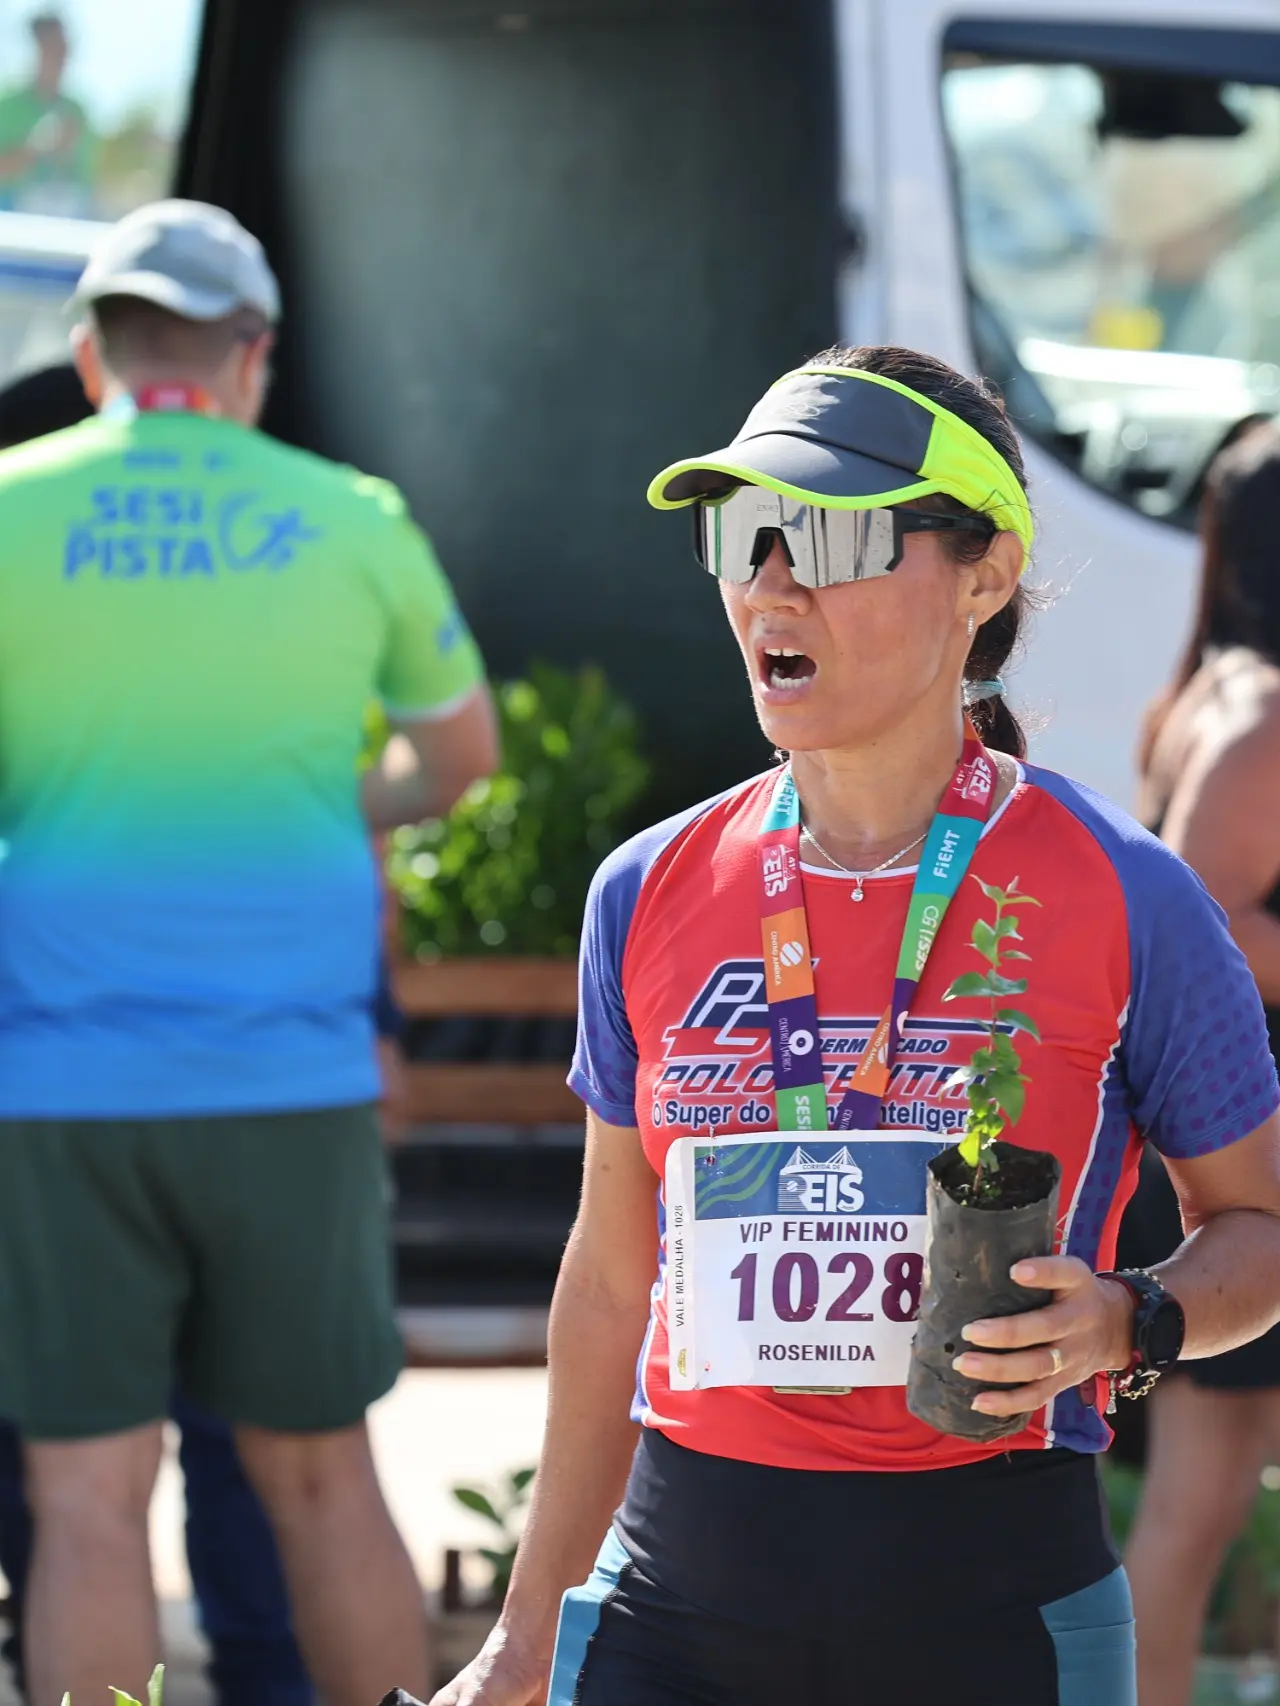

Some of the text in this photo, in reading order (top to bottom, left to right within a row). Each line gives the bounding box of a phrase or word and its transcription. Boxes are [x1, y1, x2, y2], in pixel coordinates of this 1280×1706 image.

[63, 529, 214, 577] PISTA
[666, 1101, 732, 1129] Super
[740, 1100, 770, 1122] do
[778, 1174, 865, 1213] REIS
[674, 1205, 683, 1228] 1028
[740, 1221, 908, 1243] VIP FEMININO
[675, 1238, 684, 1295] MEDALHA
[730, 1252, 924, 1323] 1028
[675, 1298, 684, 1327] VALE
[759, 1344, 875, 1362] ROSENILDA
